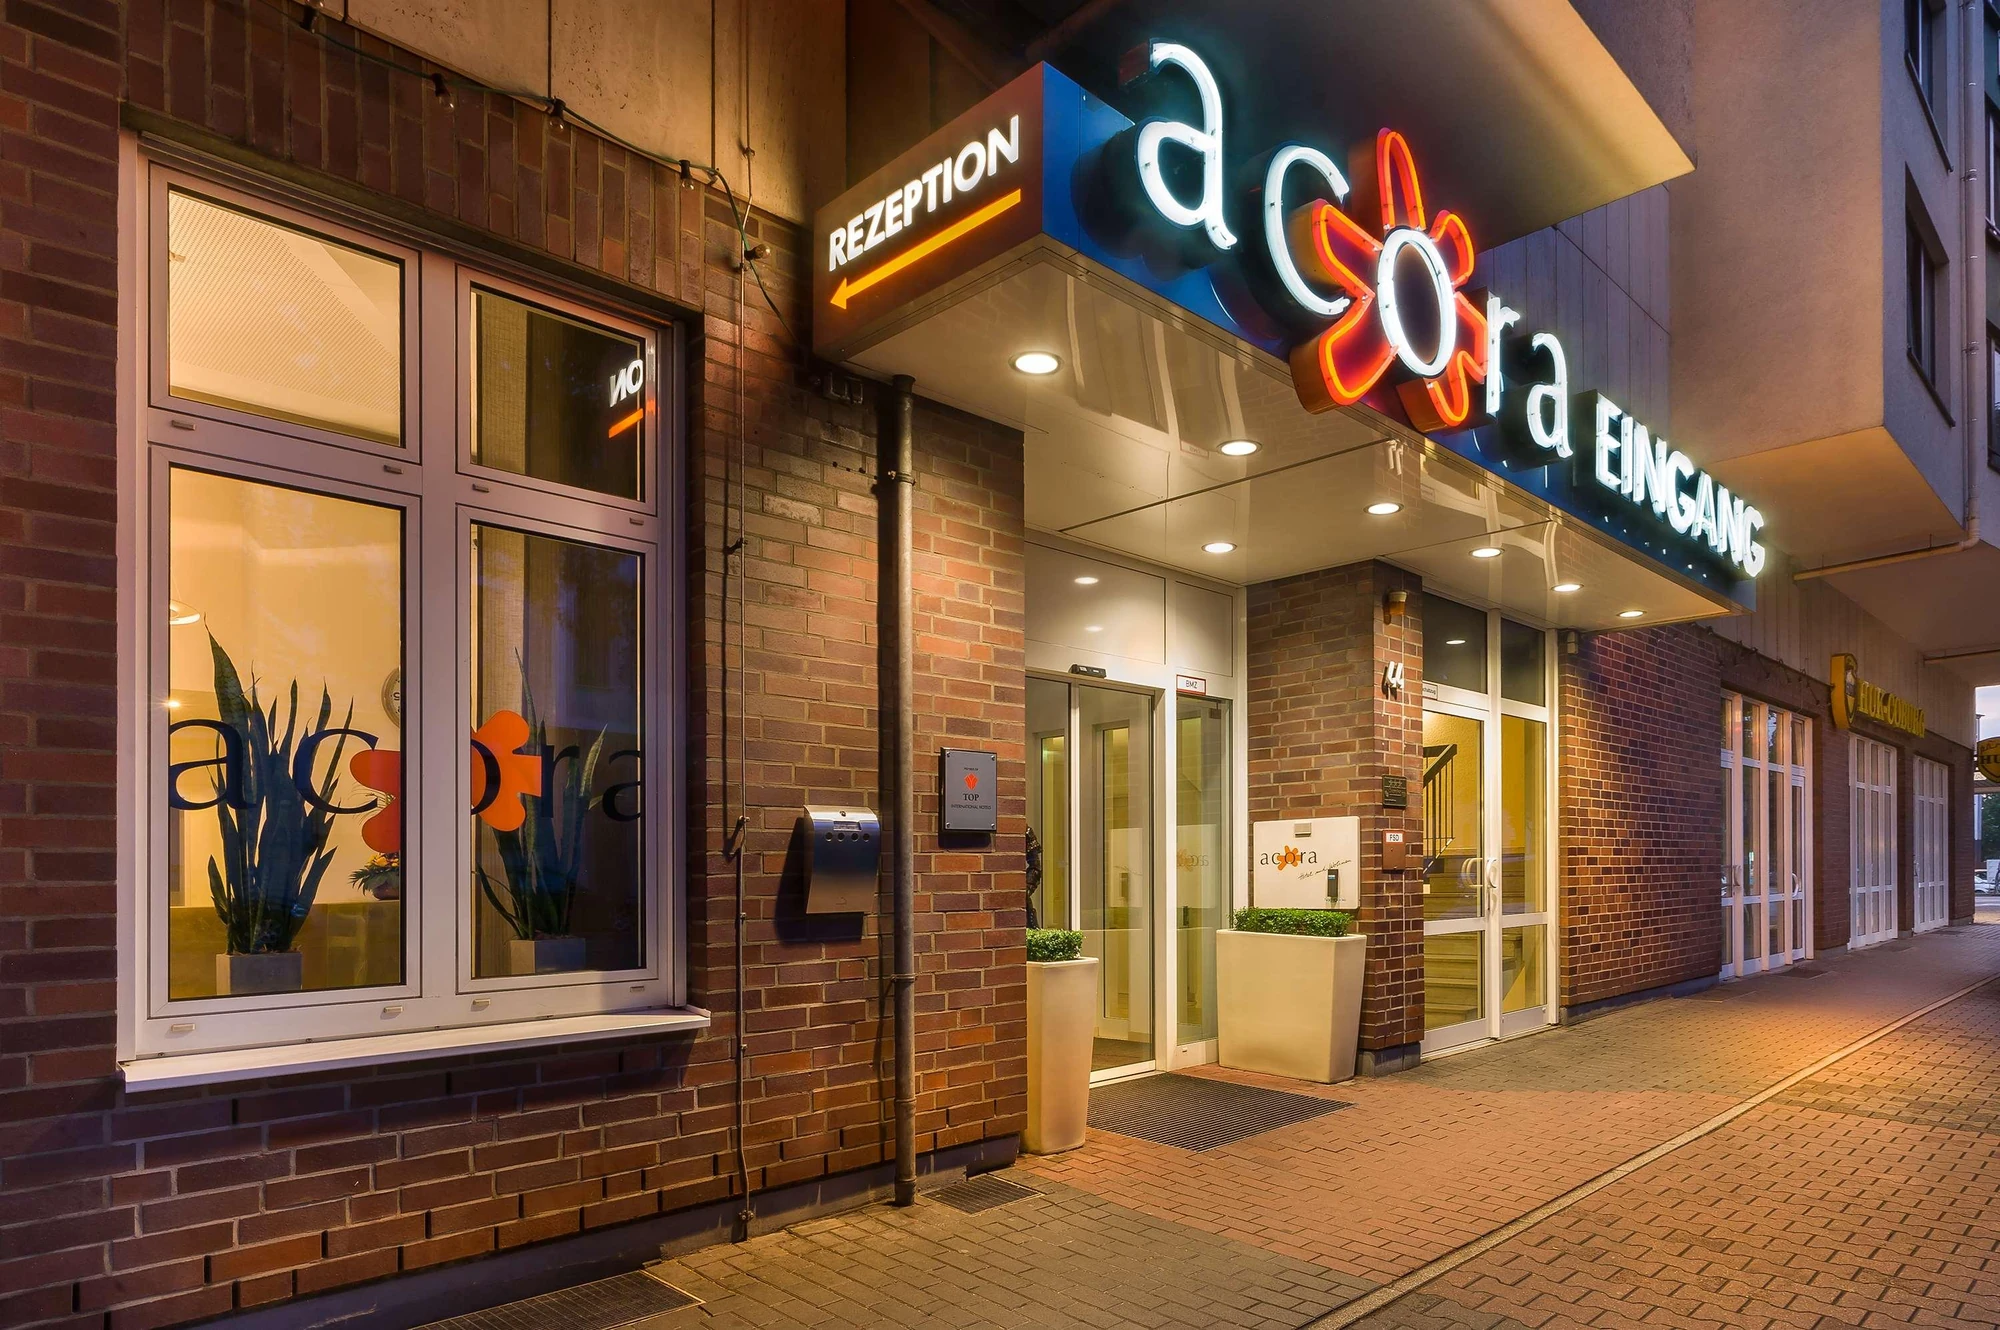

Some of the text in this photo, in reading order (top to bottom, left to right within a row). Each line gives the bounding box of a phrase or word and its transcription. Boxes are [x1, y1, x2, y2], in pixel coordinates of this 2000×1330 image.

[829, 114, 1019, 272] REZEPTION
[1136, 40, 1573, 459] acora
[1596, 393, 1765, 578] EINGANG
[1185, 679, 1198, 689] BMZ
[1387, 660, 1405, 689] 44
[1857, 679, 1925, 738] HUK-COBURG
[963, 793, 980, 802] TOP
[1259, 850, 1318, 866] acora
